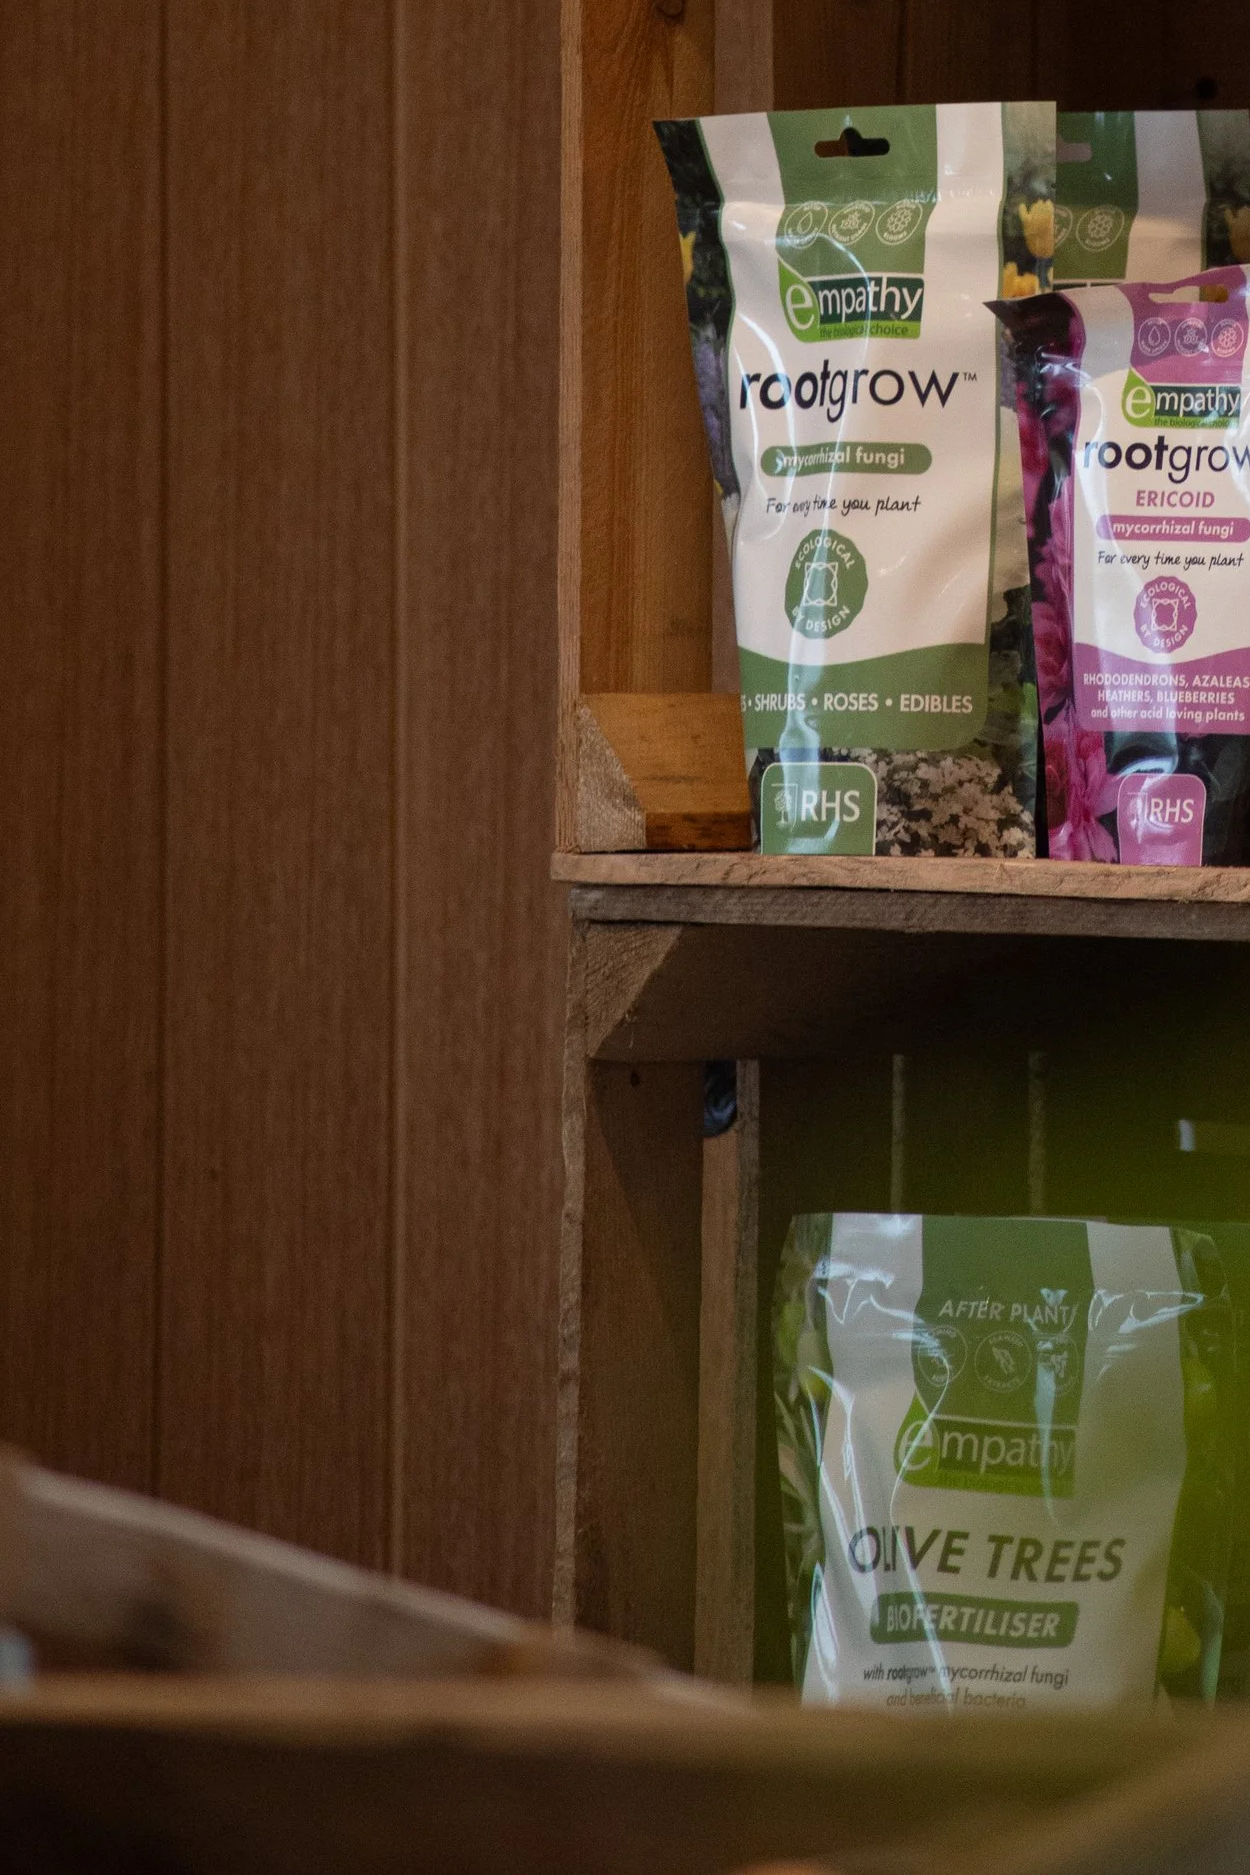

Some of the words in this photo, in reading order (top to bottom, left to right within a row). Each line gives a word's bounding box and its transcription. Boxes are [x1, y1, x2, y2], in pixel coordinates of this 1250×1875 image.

[785, 276, 923, 331] empathy
[869, 323, 909, 337] choice
[1125, 385, 1241, 420] empathy
[782, 447, 851, 470] mycorrhizal
[854, 444, 906, 470] fungi
[766, 498, 790, 514] For
[811, 497, 837, 512] time
[841, 498, 871, 516] you
[874, 495, 922, 517] plant
[1135, 490, 1215, 509] ERICOID
[1112, 518, 1195, 537] mycorrhizal
[1198, 519, 1234, 538] fungi
[794, 536, 856, 571] ECOLOGICAL
[1097, 550, 1115, 564] For
[1119, 553, 1150, 570] every
[1153, 550, 1181, 566] time
[1184, 554, 1206, 570] you
[1208, 551, 1245, 571] plant
[1140, 582, 1190, 609] ECOLOGICAL
[805, 605, 851, 633] DESIGN
[1152, 624, 1188, 648] DESIGN
[1083, 673, 1189, 689] RHODODENDRONS,
[754, 693, 806, 713] SHRUBS
[823, 692, 879, 713] ROSES
[899, 693, 973, 714] EDIBLES
[1097, 690, 1153, 705] HEATHERS,
[1156, 691, 1235, 705] BLUEBERRIES
[1090, 707, 1108, 719] and
[1110, 707, 1137, 720] other
[1140, 707, 1164, 720] acid
[1166, 707, 1203, 723] loving
[1204, 708, 1246, 723] plants
[800, 789, 861, 823] RHS
[1149, 797, 1195, 824] RHS
[938, 1299, 1002, 1321] AFTER
[1010, 1303, 1067, 1325] PLANT
[849, 1525, 970, 1575] OLIVE
[987, 1533, 1126, 1584] TREES
[886, 1604, 1061, 1640] BIOFERTILISER
[863, 1662, 885, 1681] with
[941, 1663, 1028, 1683] mycorrhizal
[1030, 1664, 1070, 1690] fungi
